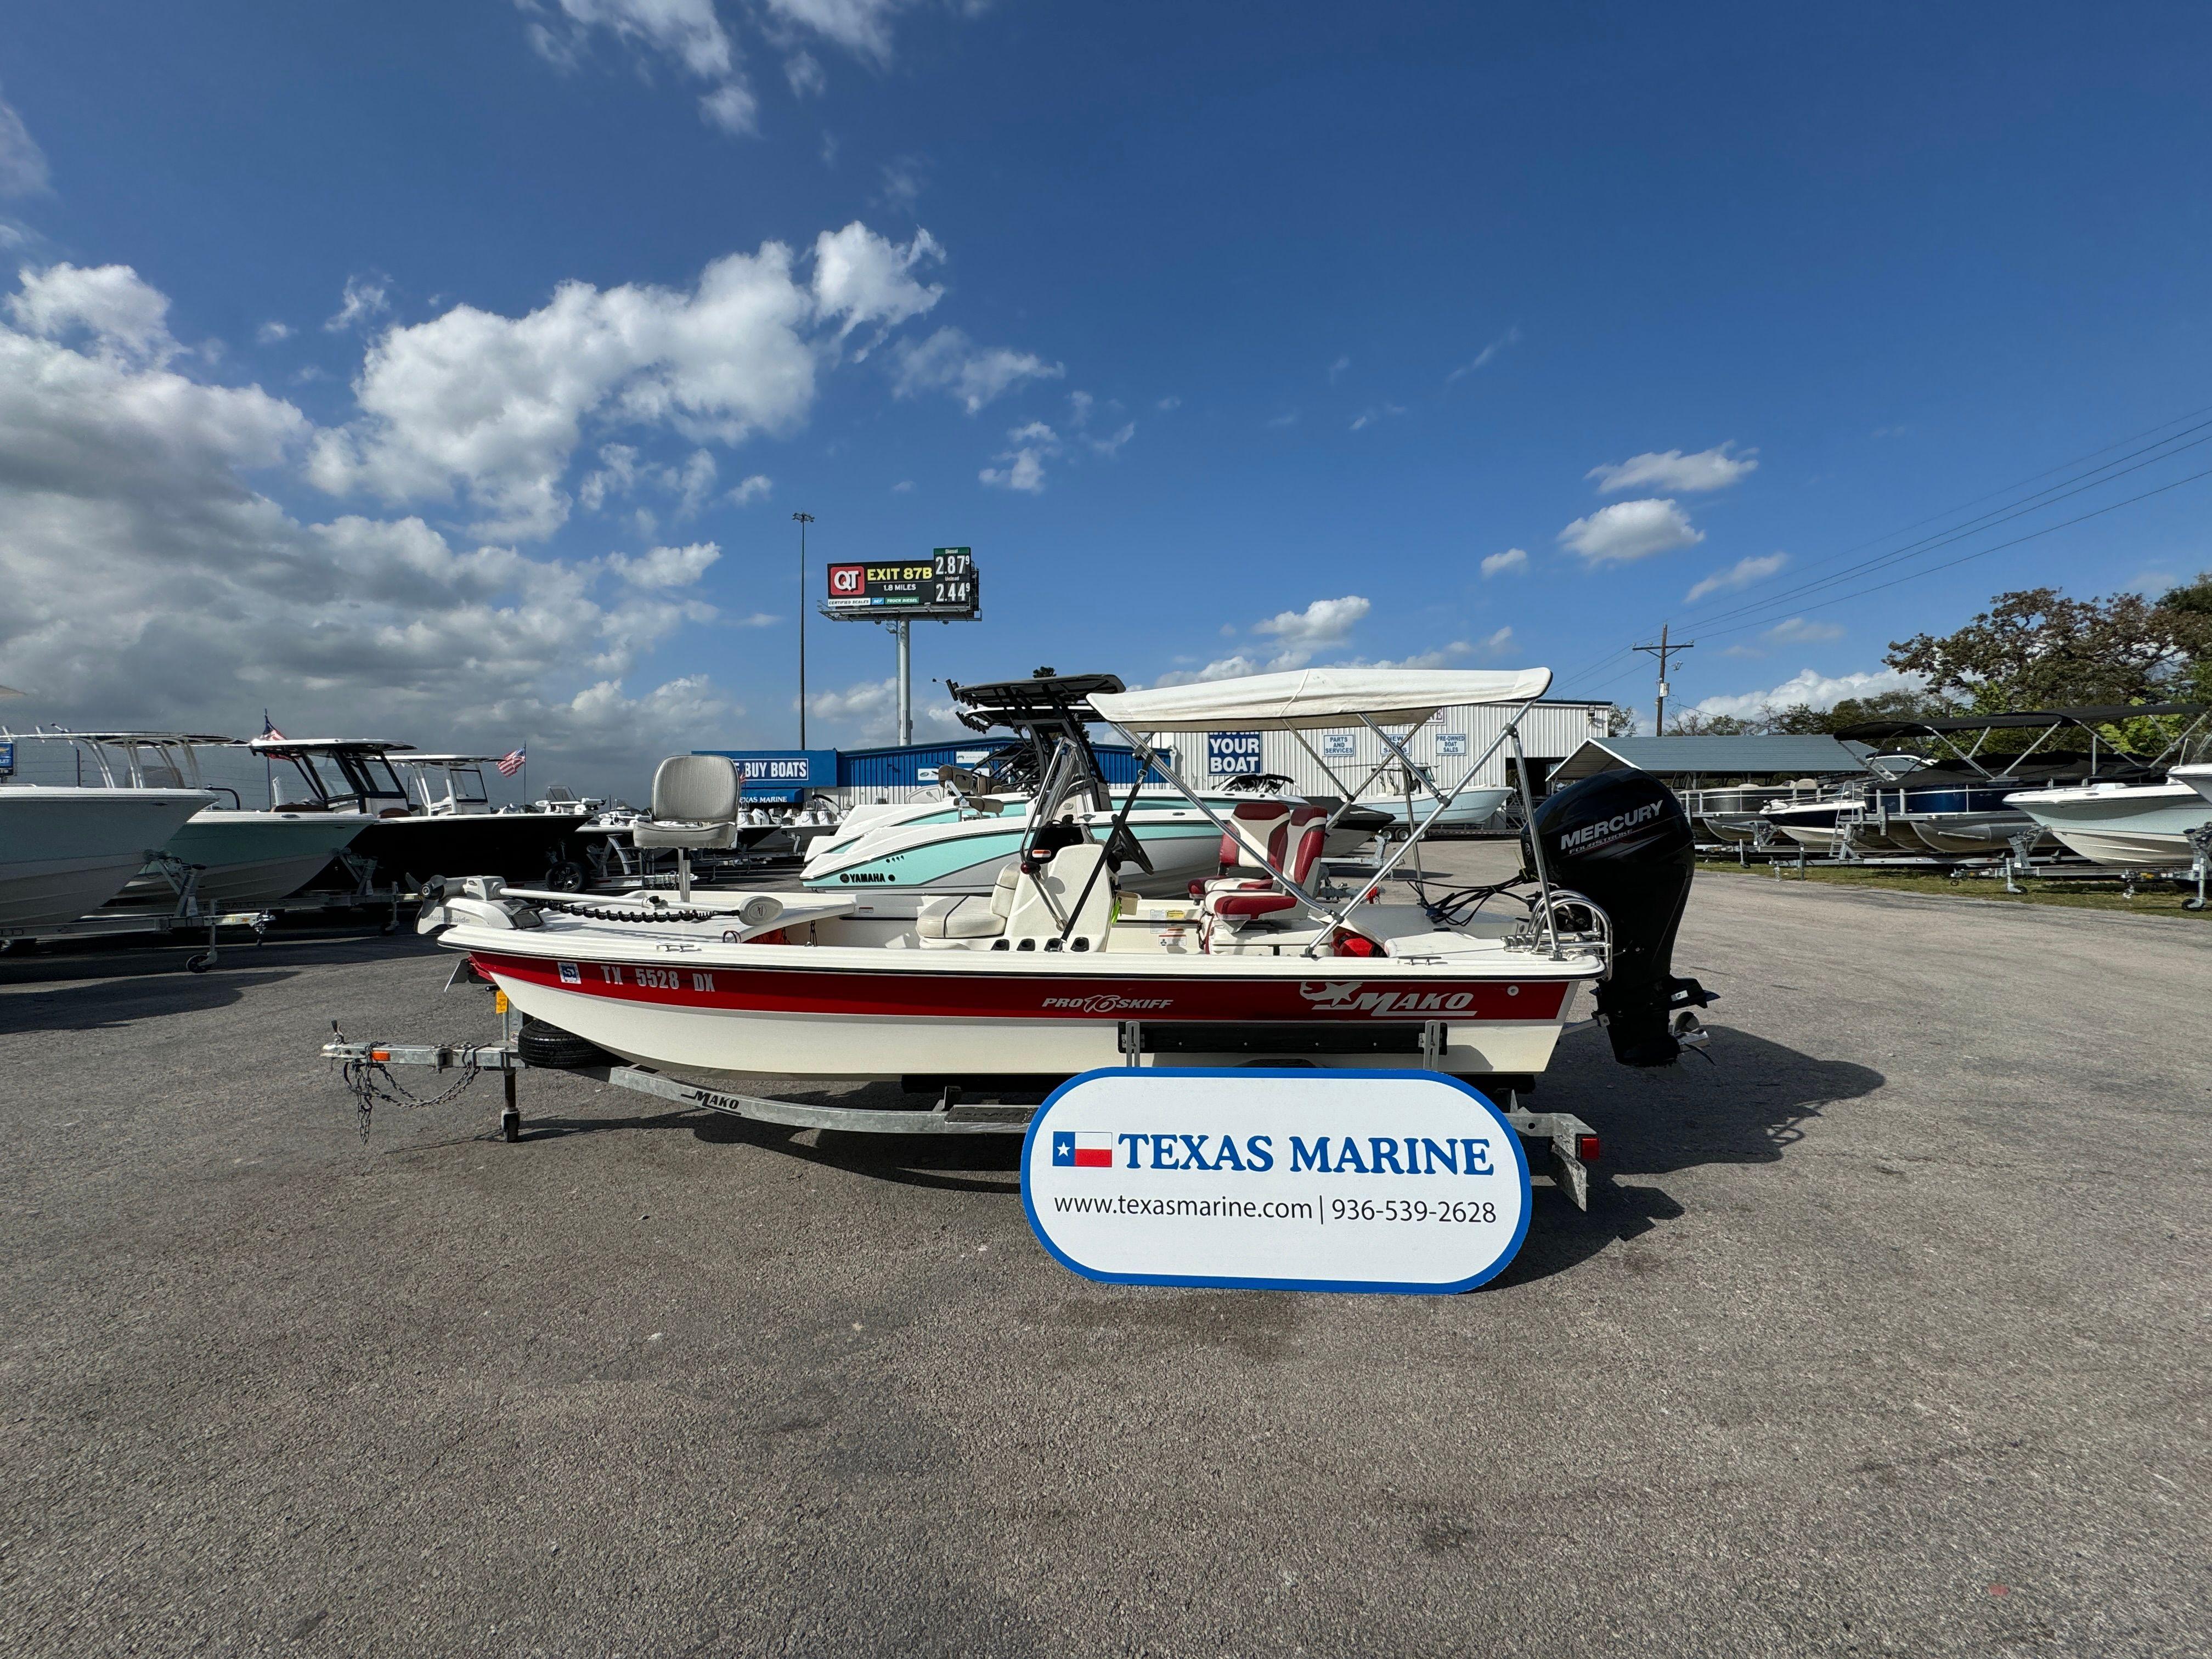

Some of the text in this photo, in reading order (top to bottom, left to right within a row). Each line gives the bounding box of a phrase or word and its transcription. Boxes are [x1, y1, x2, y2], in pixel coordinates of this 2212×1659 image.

[834, 571, 859, 591] QT
[867, 567, 933, 581] EXIT 87B
[1209, 738, 1259, 754] YOUR
[745, 761, 767, 777] BUY
[771, 761, 806, 777] BOATS
[1210, 757, 1259, 772] BOAT
[1561, 800, 1663, 850] MERCURY
[1569, 828, 1633, 855] FOURSTROKE
[849, 873, 886, 883] YAMAHA
[428, 915, 470, 923] MotorGuide
[600, 966, 623, 985] TX
[635, 968, 680, 989] 5528
[692, 973, 715, 992] DX
[1042, 998, 1084, 1008] PRO
[1116, 999, 1174, 1008] SKIFF
[1312, 992, 1477, 1016] MAKO
[681, 1091, 741, 1115] MAKO
[1118, 1133, 1494, 1176] TEXAS MARINE
[1054, 1195, 1497, 1223] www.texasmarine.com 936-539-2628
